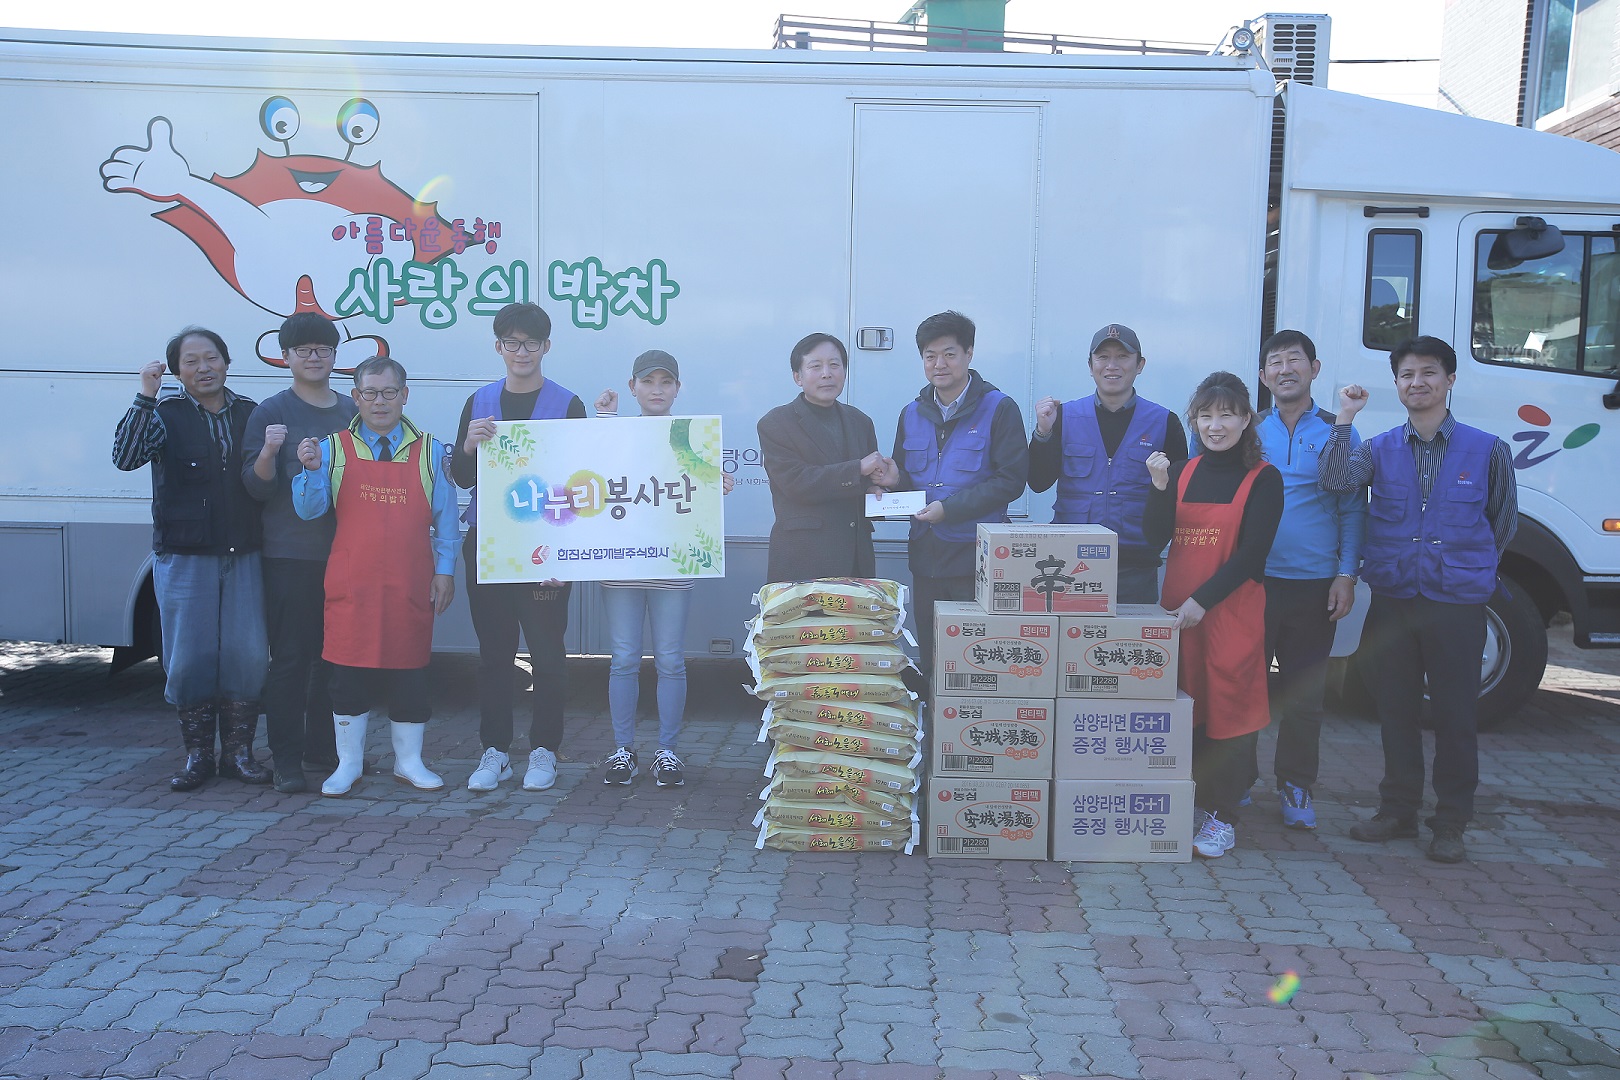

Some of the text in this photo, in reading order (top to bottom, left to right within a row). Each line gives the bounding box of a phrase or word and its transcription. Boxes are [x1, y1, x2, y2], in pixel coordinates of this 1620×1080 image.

[334, 256, 681, 331] 사랑의 밥차
[1011, 547, 1037, 558] 농심
[1080, 546, 1108, 557] 멀티팩
[1030, 554, 1076, 613] 辛
[1074, 581, 1103, 594] 라면
[962, 627, 986, 637] 농심
[1023, 626, 1048, 636] 멀티팩
[1083, 629, 1107, 639] 농심
[1144, 628, 1169, 638] 멀티팩
[972, 644, 1043, 665] 安城湯麵
[1094, 646, 1164, 667] 安城湯麵
[959, 709, 982, 719] 농심
[1020, 709, 1044, 719] 멀티팩
[1073, 713, 1165, 732] 삼양라면 5+1
[969, 726, 1039, 747] 安城湯麵
[1072, 736, 1167, 755] 증정 행사용
[953, 792, 977, 801] 농심
[1014, 790, 1039, 801] 멀티팩
[1072, 794, 1164, 814] 삼양라면 5+1
[964, 808, 1034, 829] 安城湯麵
[1072, 817, 1167, 836] 증정 행사용
